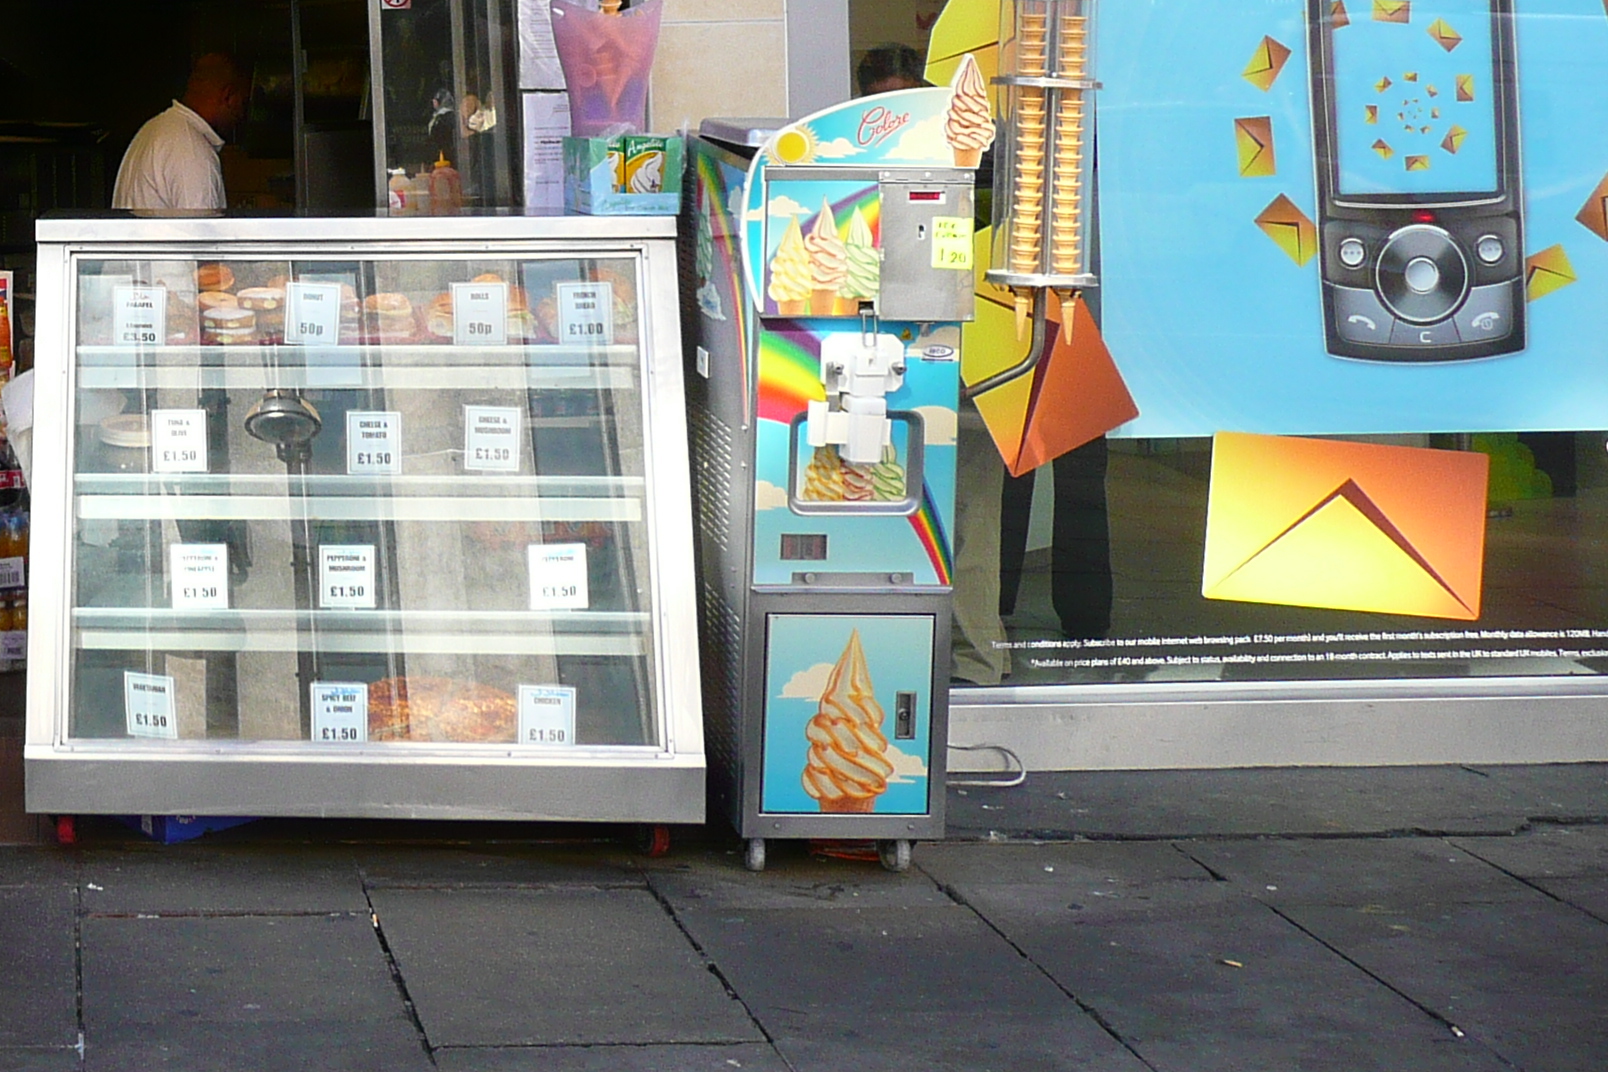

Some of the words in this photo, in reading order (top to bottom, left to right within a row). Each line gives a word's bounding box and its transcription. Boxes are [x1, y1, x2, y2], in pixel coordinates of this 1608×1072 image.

[857, 105, 911, 147] Colore
[299, 321, 324, 337] 50p
[468, 322, 493, 337] 50p
[568, 322, 605, 336] £1.00
[123, 331, 157, 343] £3.50
[1419, 331, 1431, 343] C
[356, 452, 392, 466] £1.50
[475, 447, 510, 461] £1.50
[329, 585, 365, 598] £1.50
[135, 712, 168, 728] £1.50
[321, 727, 358, 741] £1.50
[528, 728, 565, 743] £1.50
